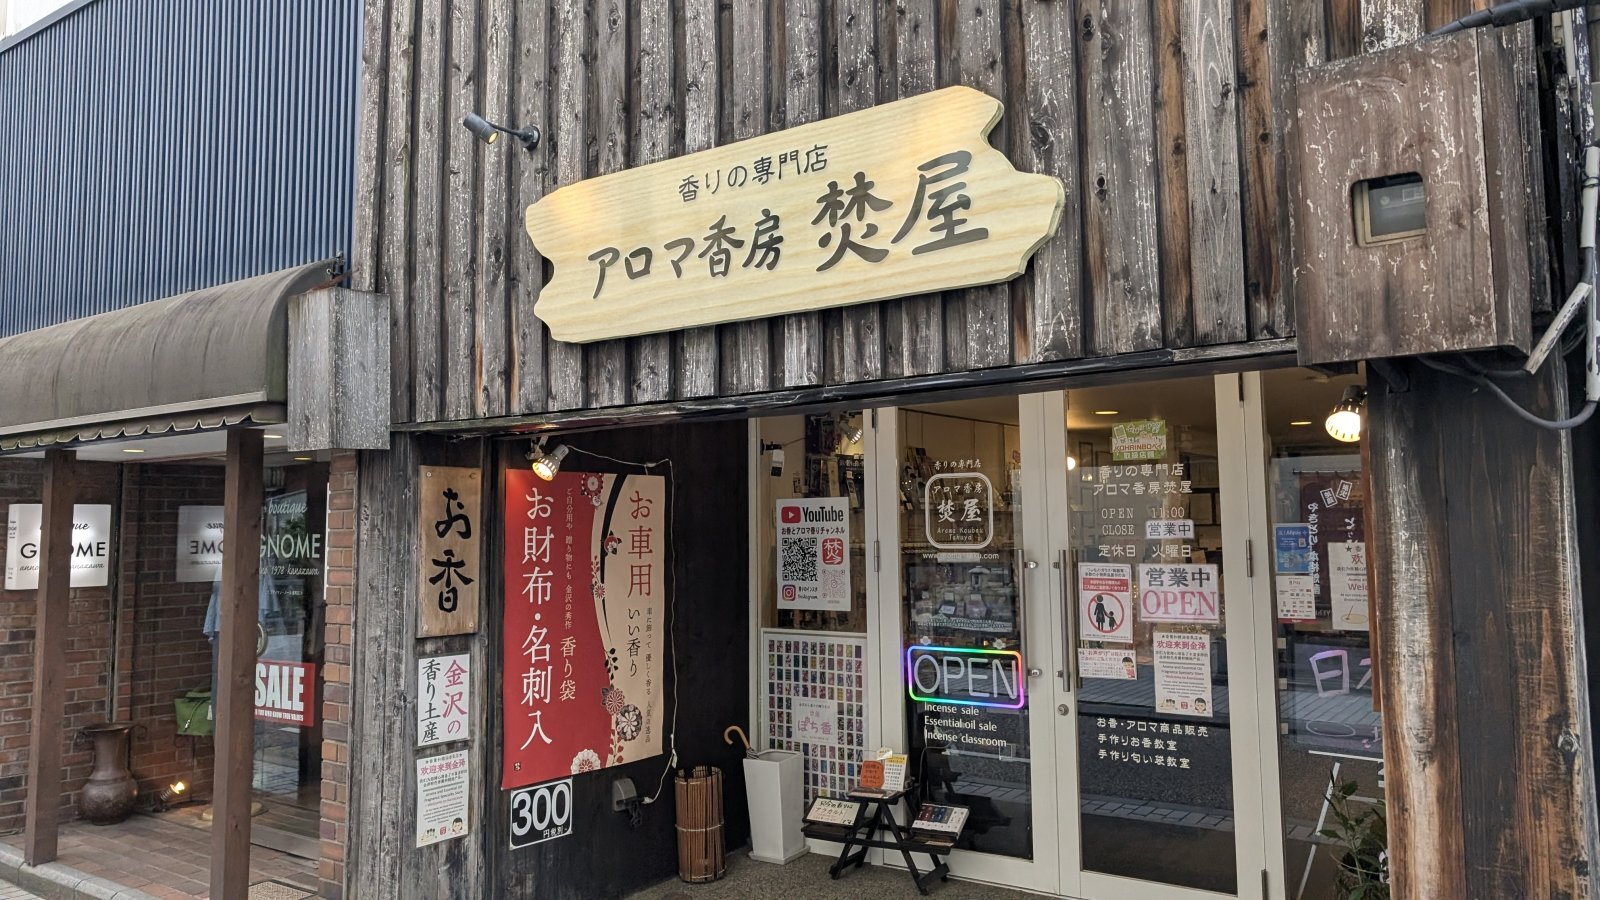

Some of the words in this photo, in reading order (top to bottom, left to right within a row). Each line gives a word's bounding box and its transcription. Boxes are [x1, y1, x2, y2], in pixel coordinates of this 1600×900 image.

[678, 144, 829, 203] 香りの専門店
[587, 208, 784, 300] アロマ香房
[810, 150, 989, 273] 焚屋
[934, 459, 981, 470] 香りの専門店
[1100, 463, 1185, 478] 香りの専門店
[932, 483, 983, 494] アロマ香房
[1093, 480, 1193, 496] アロマ香房焚屋
[268, 499, 308, 521] boutique
[802, 506, 844, 522] YouTube
[937, 498, 981, 522] 焚屋
[1101, 508, 1134, 519] OPEN
[1151, 507, 1185, 518] 11:00
[1102, 524, 1135, 535] CLOSE
[1147, 522, 1191, 536] 営業中
[20, 541, 106, 558] GME
[428, 487, 474, 613] お香
[627, 490, 653, 598] お車用
[1098, 545, 1136, 557] 定休日
[1152, 545, 1192, 557] 火曜日
[1145, 567, 1211, 587] 営業中
[1142, 590, 1217, 616] OPEN
[520, 487, 555, 750] お財布・名刺入
[626, 607, 641, 678] いい香り
[559, 636, 577, 701] 香り袋
[914, 655, 1017, 699] OPEN
[255, 663, 304, 711] SALE
[443, 659, 468, 734] 金沢の
[420, 659, 441, 743] 香り土産
[925, 702, 957, 713] Incense
[961, 706, 980, 715] sale
[924, 716, 962, 728] Essential
[965, 720, 976, 729] oil
[979, 721, 997, 732] sale
[1096, 718, 1209, 737] お香・アロマ商品販売
[925, 730, 958, 741] Incense
[961, 734, 1007, 747] classroom
[1098, 734, 1178, 751] 手作りお香教室
[1098, 749, 1191, 769] 手作り匂い袋教室
[512, 783, 571, 836] 300
